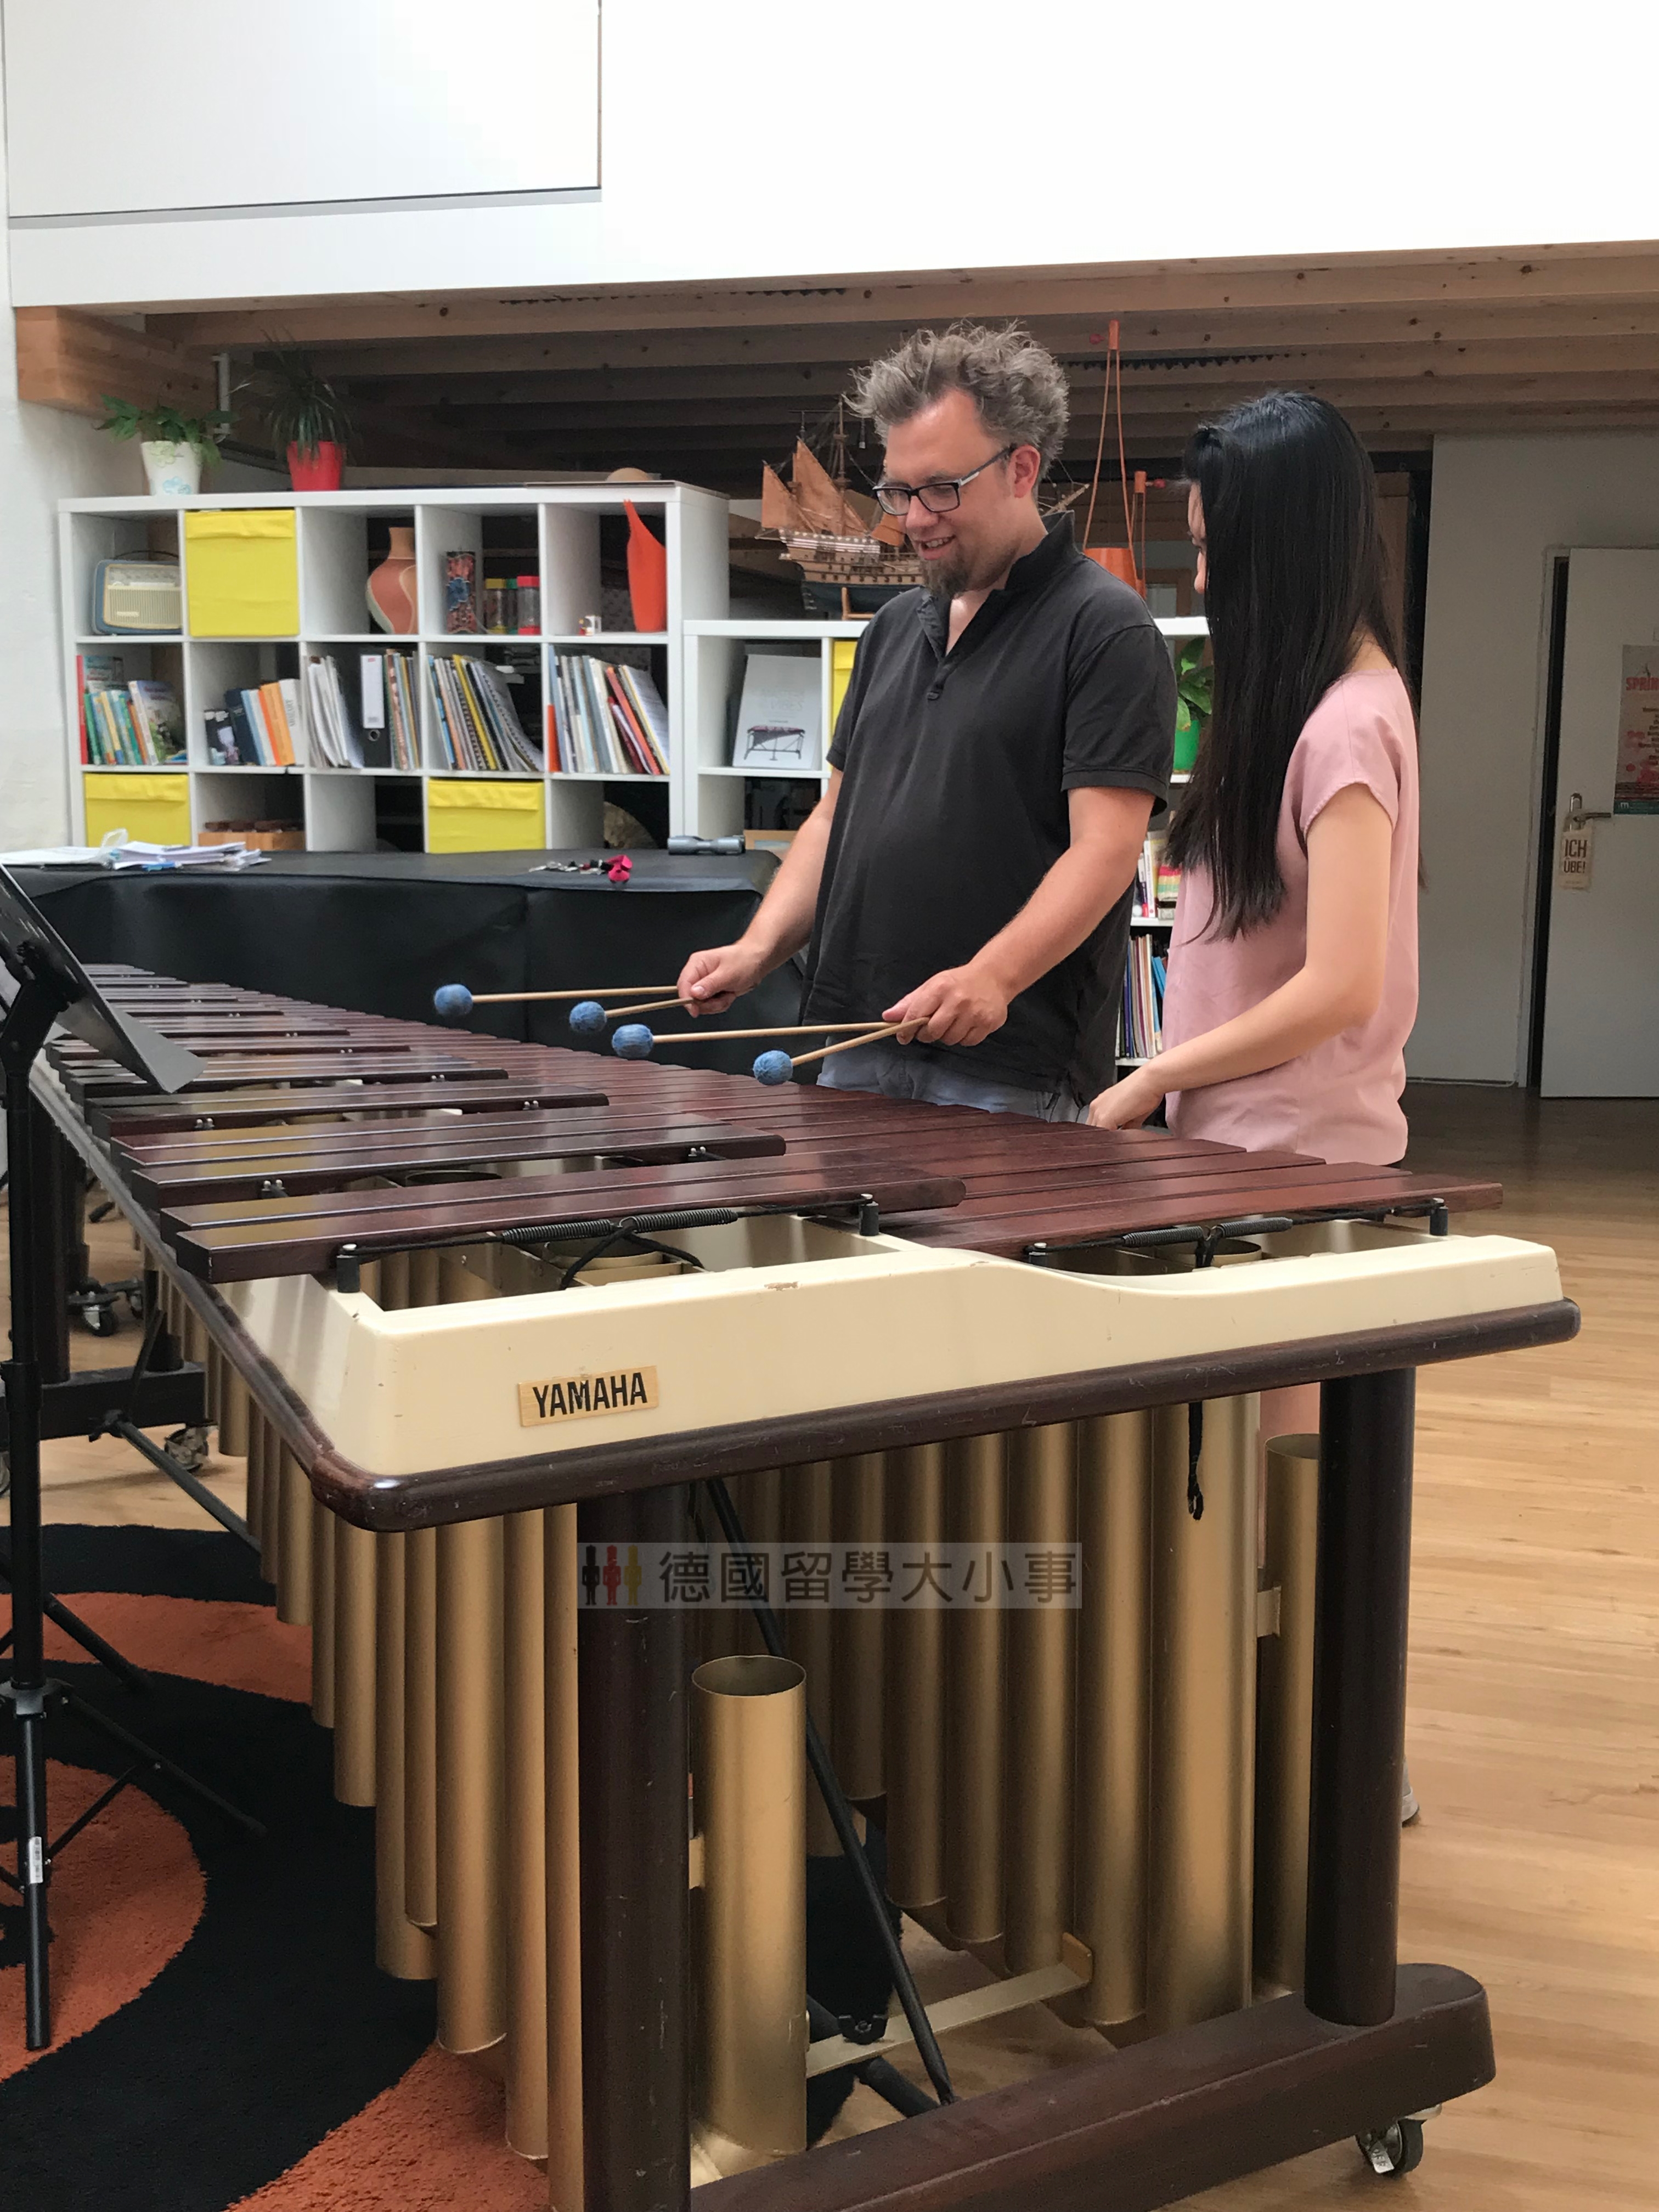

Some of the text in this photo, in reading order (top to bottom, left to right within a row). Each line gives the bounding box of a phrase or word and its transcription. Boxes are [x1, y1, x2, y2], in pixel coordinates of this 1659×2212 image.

[1565, 839, 1588, 858] ICH
[1563, 857, 1585, 873] ÜBE!
[533, 1372, 647, 1418] YAMAHA
